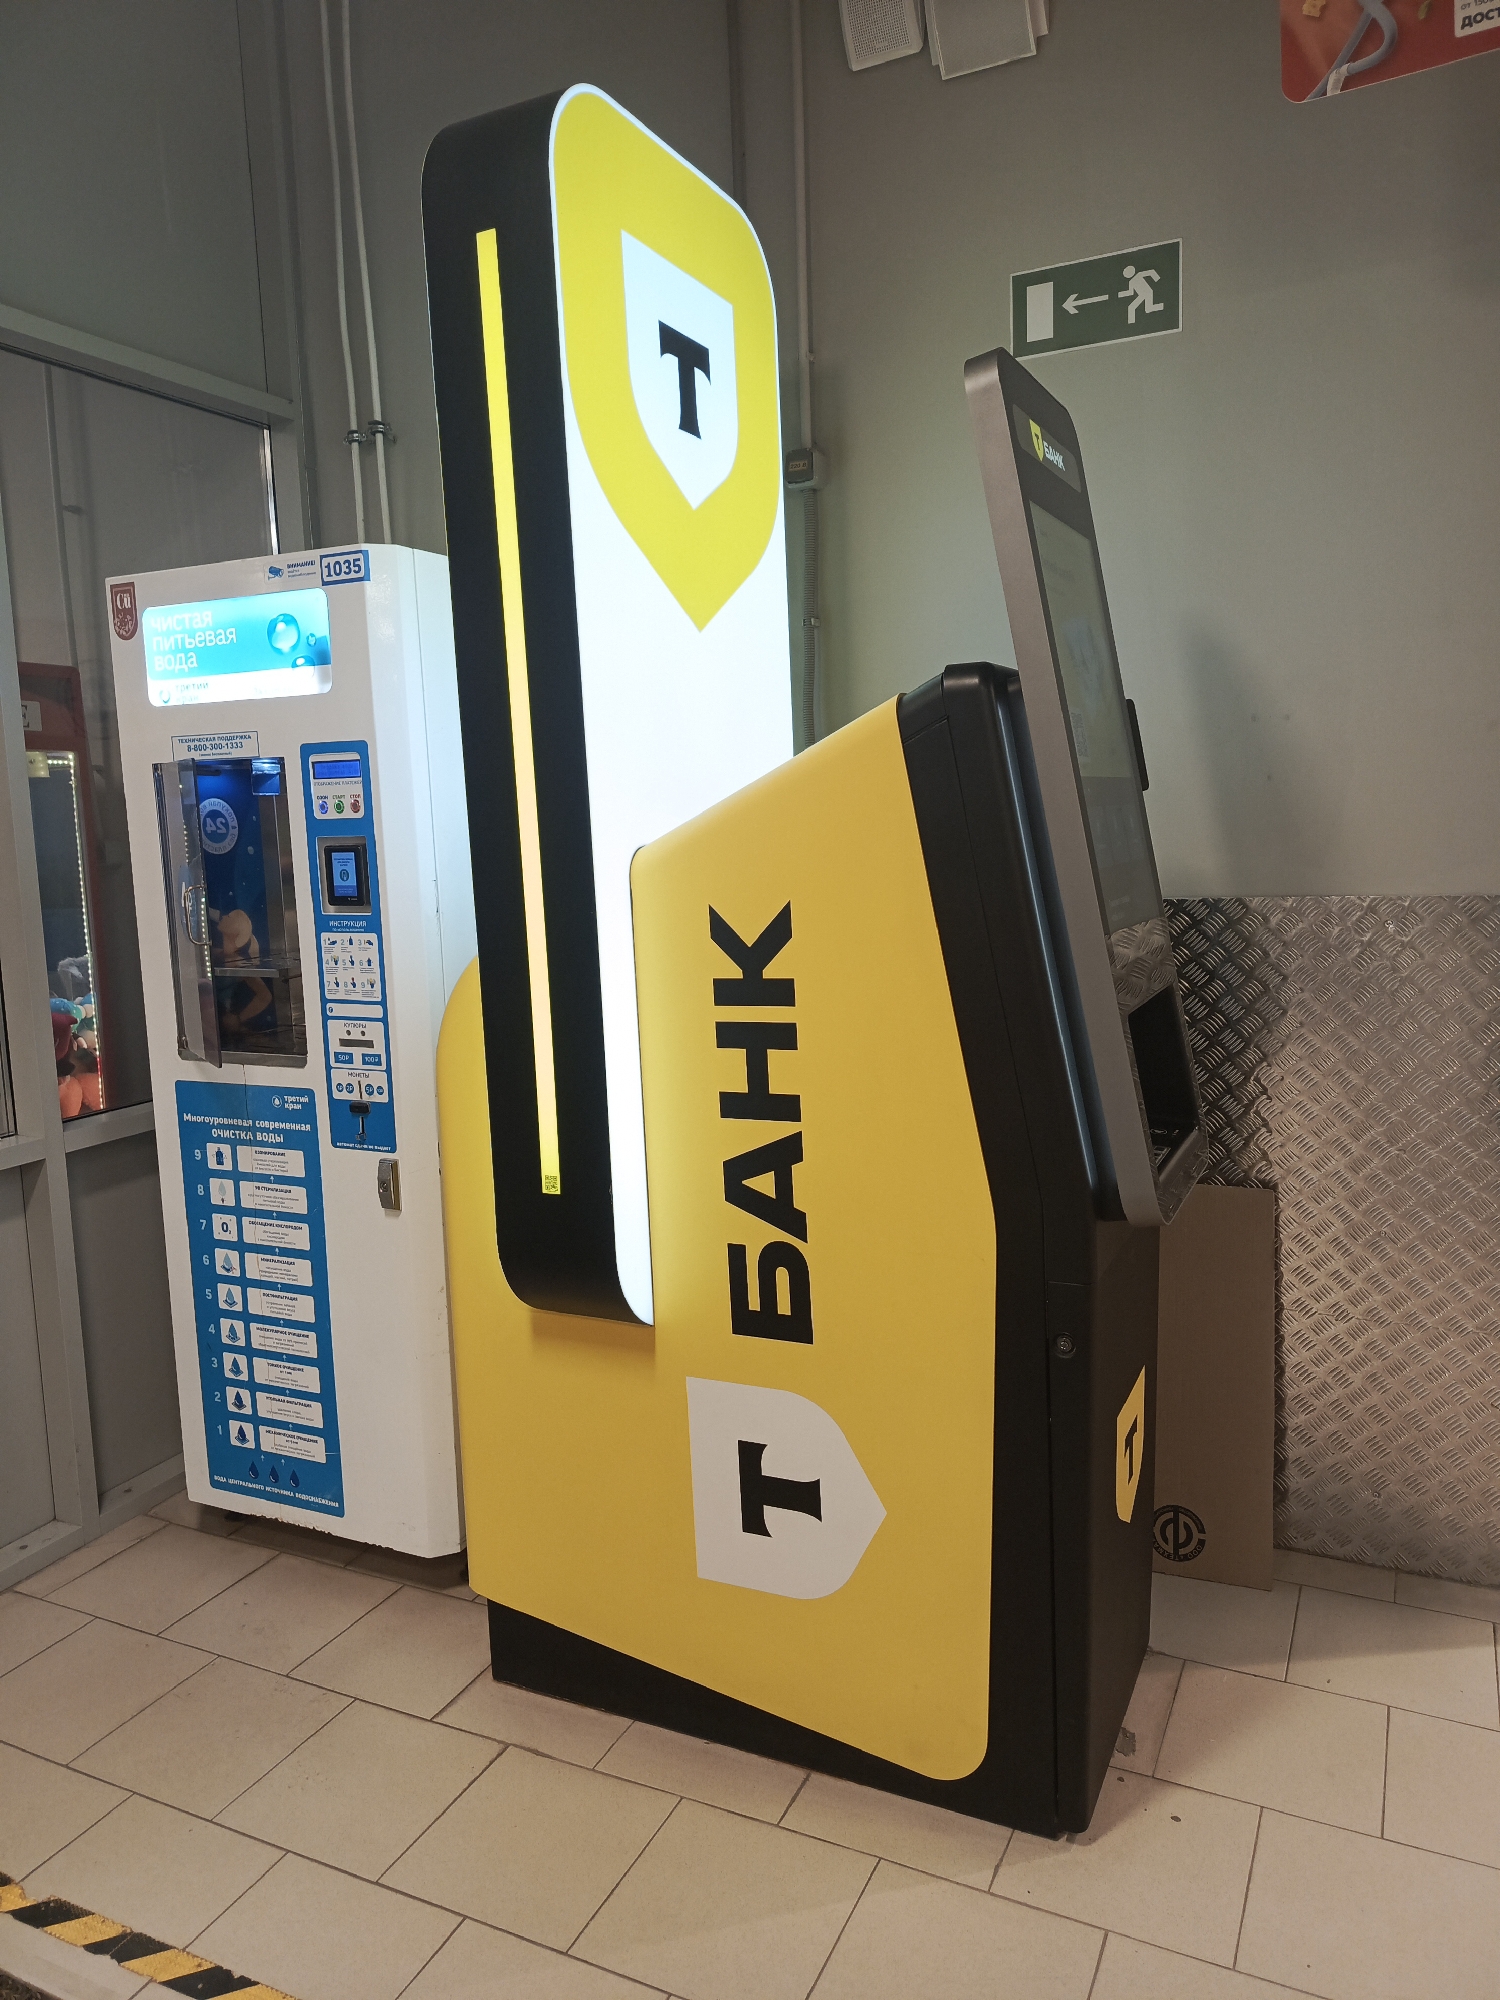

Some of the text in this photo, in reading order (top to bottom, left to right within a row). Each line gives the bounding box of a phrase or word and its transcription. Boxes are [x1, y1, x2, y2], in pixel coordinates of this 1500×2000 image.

[1042, 440, 1066, 471] БАНК
[325, 558, 362, 577] 1035
[152, 611, 212, 633] чистая
[153, 628, 237, 652] питьевая
[154, 653, 198, 674] вода
[187, 742, 244, 752] 8-800-300-1333
[284, 1095, 309, 1103] третий
[184, 1113, 311, 1131] Многоуровневая современная
[708, 900, 814, 1346] БАНК
[212, 1128, 284, 1143] ОЧИСТКА ВОДЫ
[194, 1149, 201, 1160] 9
[198, 1184, 204, 1195] 8
[200, 1220, 206, 1230] 7
[203, 1255, 209, 1265] 6
[206, 1289, 212, 1299] 5
[208, 1324, 215, 1334] 4
[212, 1358, 218, 1367] 3
[214, 1392, 221, 1402] 2
[217, 1425, 223, 1435] 1
[228, 1477, 265, 1490] ЦЕНТРАЛЬНОГО
[266, 1486, 294, 1497] ИСТОЧНИКА
[296, 1492, 339, 1507] ВОДОСНАБЖЕНИЯ
